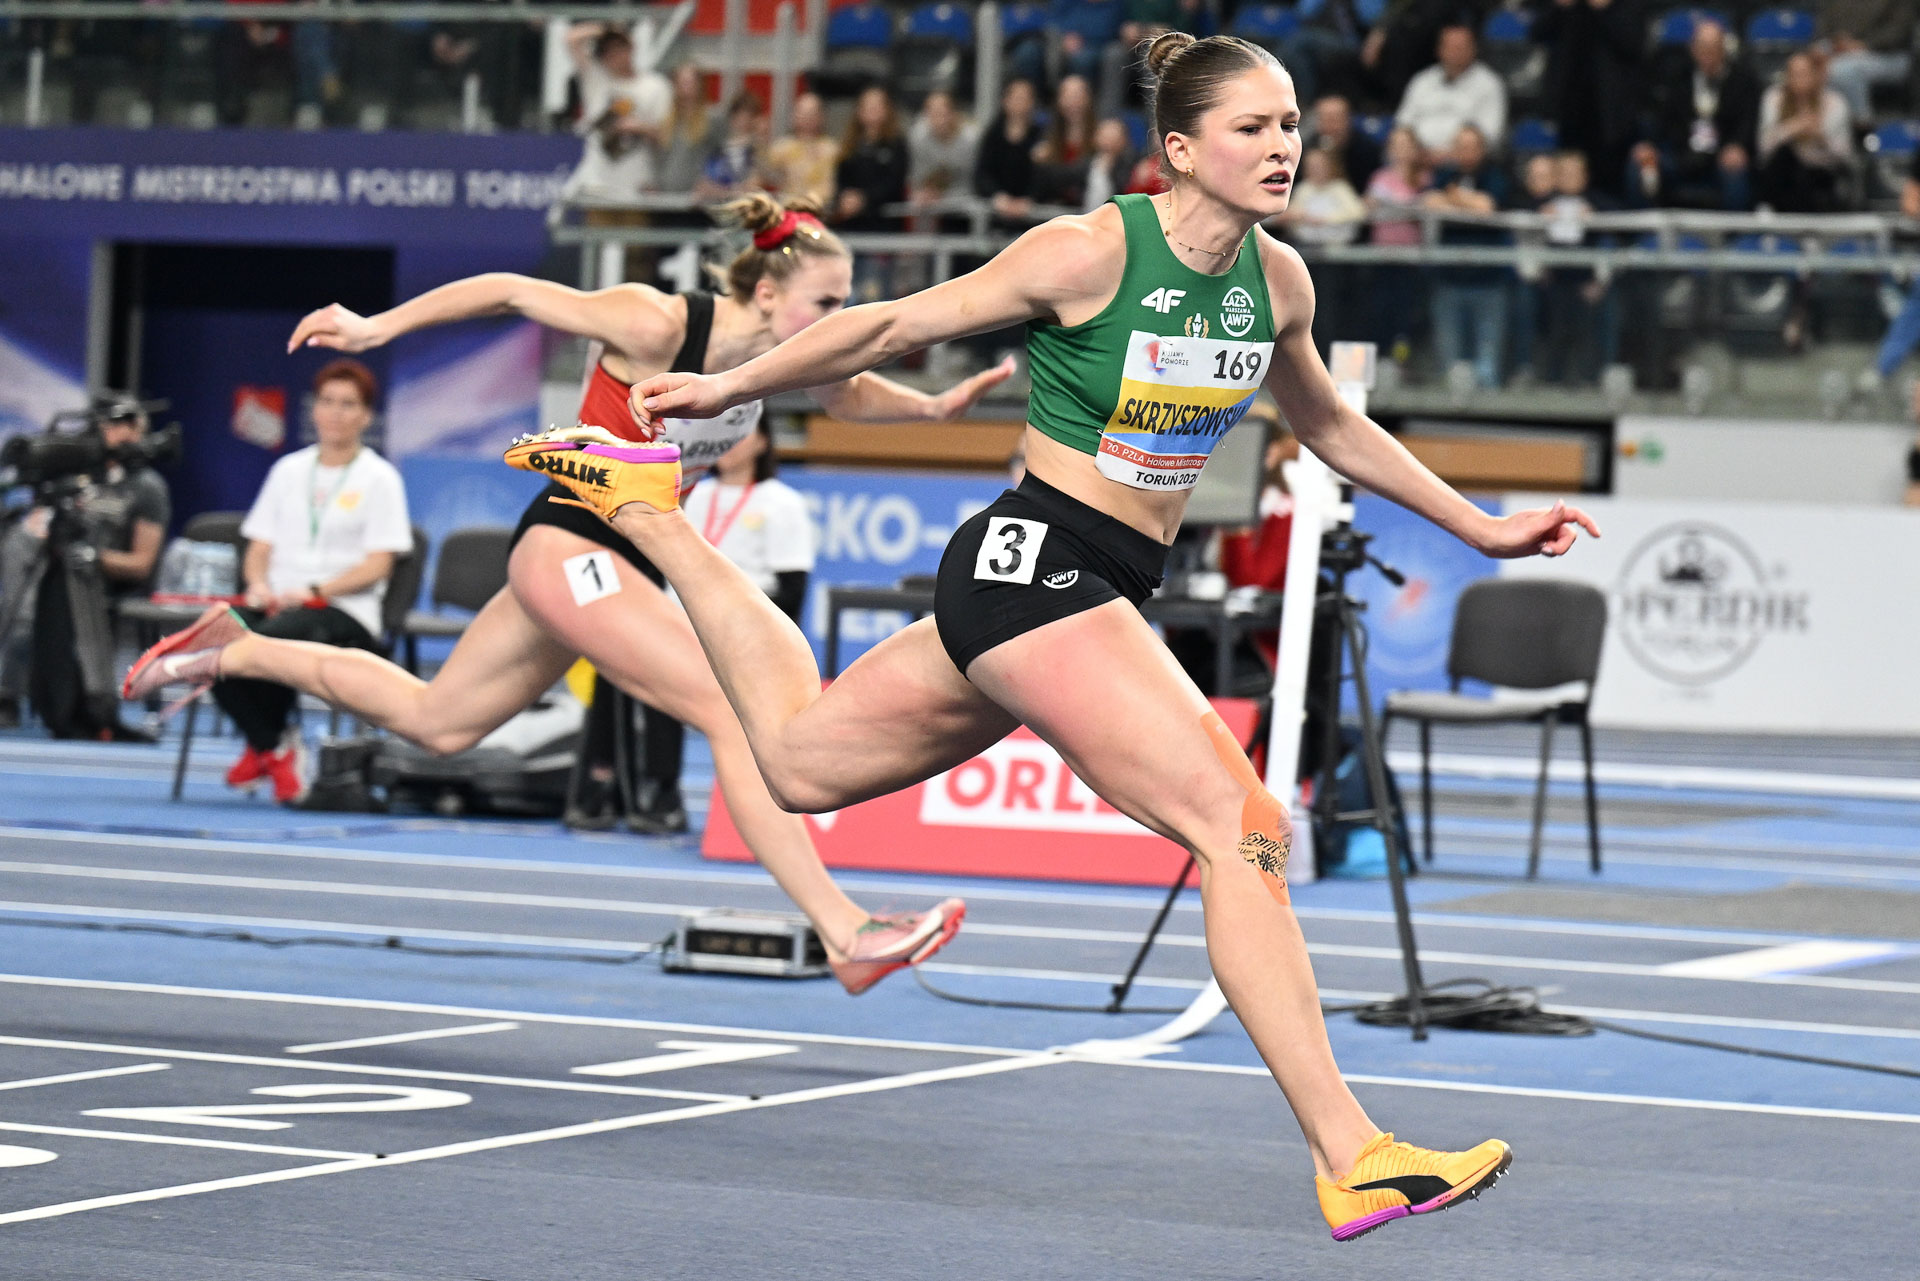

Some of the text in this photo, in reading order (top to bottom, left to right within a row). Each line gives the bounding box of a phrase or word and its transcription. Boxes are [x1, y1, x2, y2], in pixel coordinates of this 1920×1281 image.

[132, 165, 340, 204] MISTRZOSTWA
[349, 168, 454, 207] POLSKI
[1141, 287, 1187, 314] 4F
[1228, 295, 1247, 308] AZS
[1226, 314, 1251, 327] AWF
[1213, 350, 1262, 381] 169
[1106, 441, 1120, 455] 70.
[1122, 448, 1145, 464] PZLA
[1146, 457, 1175, 467] Halowe
[529, 452, 612, 489] NITRO
[1135, 471, 1178, 486] TORUŃ
[989, 523, 1027, 576] 3
[582, 558, 604, 591] 1
[1050, 571, 1075, 584] AWF
[944, 756, 1126, 816] ORL
[82, 1083, 472, 1130] 2
